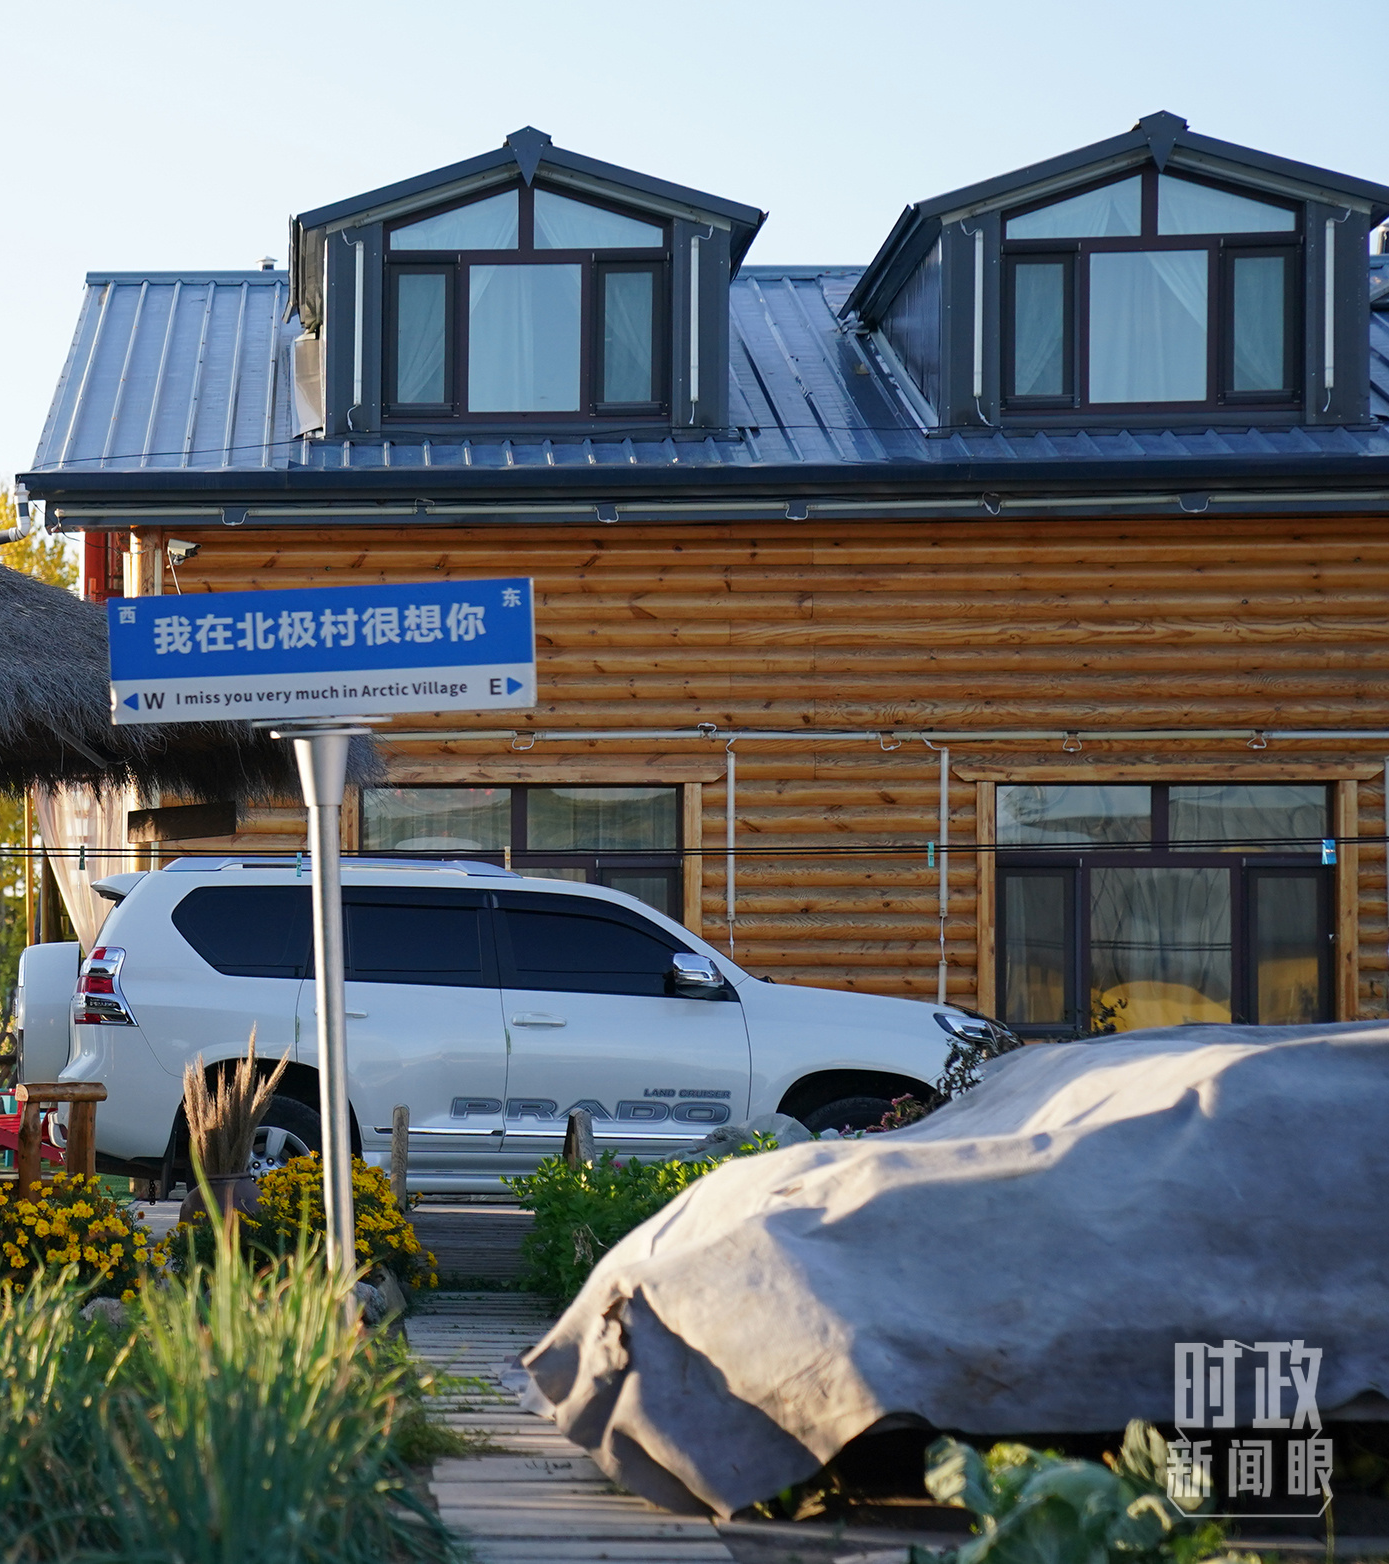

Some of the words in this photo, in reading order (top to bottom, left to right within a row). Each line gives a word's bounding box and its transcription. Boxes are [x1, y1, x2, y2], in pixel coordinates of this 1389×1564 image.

[501, 587, 522, 608] 东
[117, 606, 137, 624] 西
[153, 602, 487, 655] 我在北极村很想你
[185, 691, 220, 705] miss
[224, 692, 253, 706] you
[256, 689, 291, 704] very
[296, 685, 339, 700] much
[343, 685, 358, 698] in
[361, 682, 409, 697] Arctic
[412, 681, 468, 697] Village
[489, 678, 502, 695] E
[144, 692, 165, 710] W
[643, 1088, 676, 1098] LAND
[678, 1088, 732, 1099] CRUISER
[451, 1097, 732, 1125] PRADO
